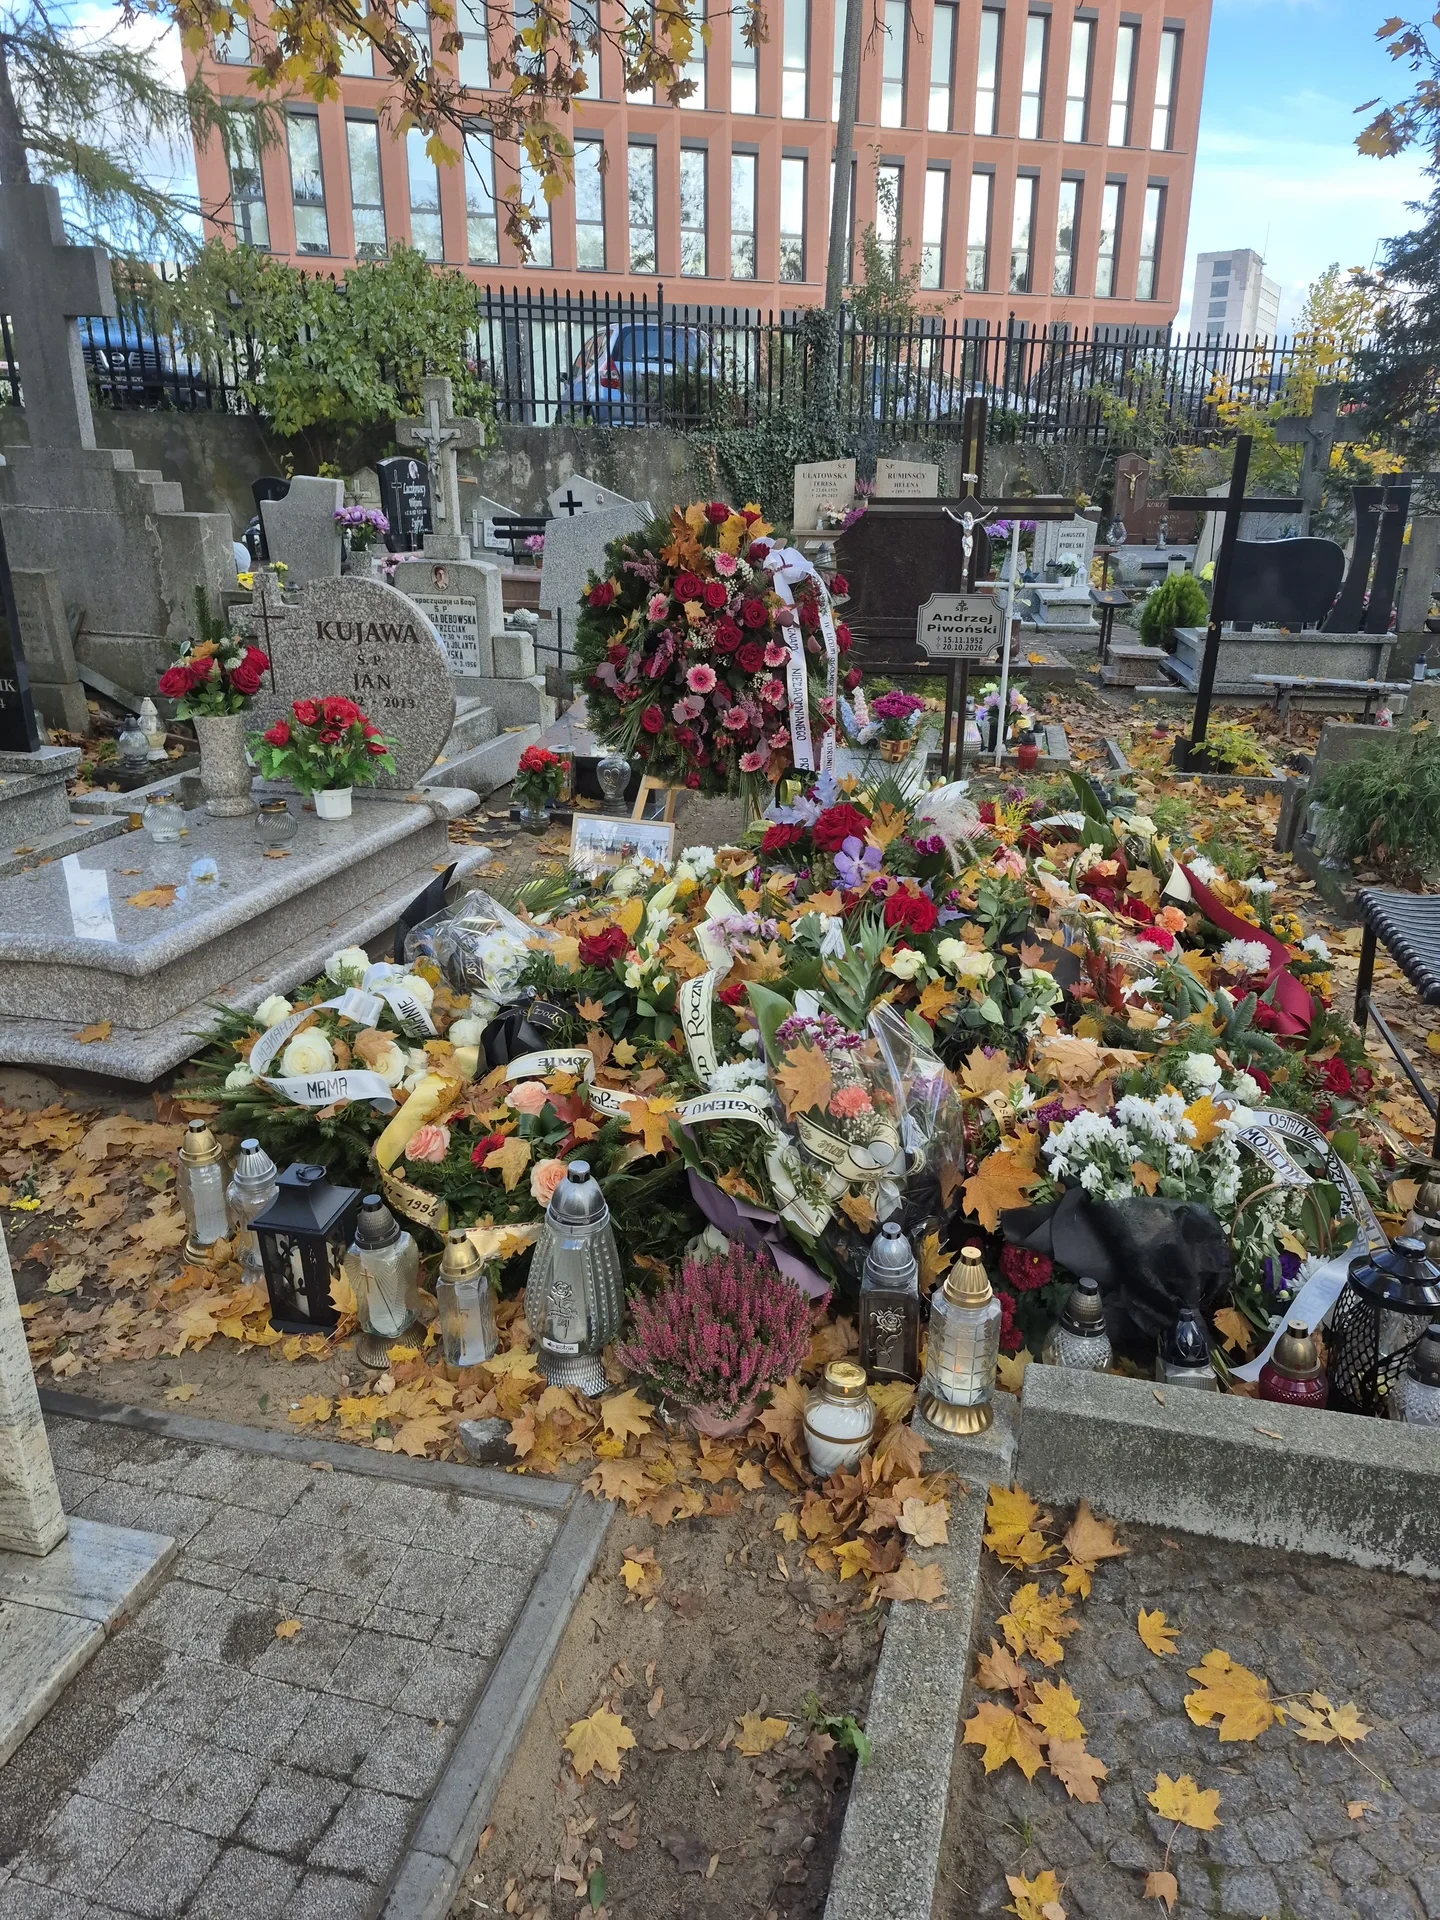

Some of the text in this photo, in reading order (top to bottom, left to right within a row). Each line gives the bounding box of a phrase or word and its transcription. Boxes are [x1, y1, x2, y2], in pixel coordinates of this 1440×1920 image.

[932, 613, 993, 624] Andrzej
[315, 620, 421, 646] KUJAWA
[927, 624, 997, 634] Piwoński
[943, 636, 983, 644] 15.11.1952
[353, 673, 392, 691] JAN
[384, 697, 415, 709] 2013
[792, 668, 807, 741] NIEZAPOMNIANEGO
[306, 1077, 348, 1099] MAMA
[1268, 1114, 1321, 1146] OSTATNIE
[406, 1198, 439, 1218] 1998
